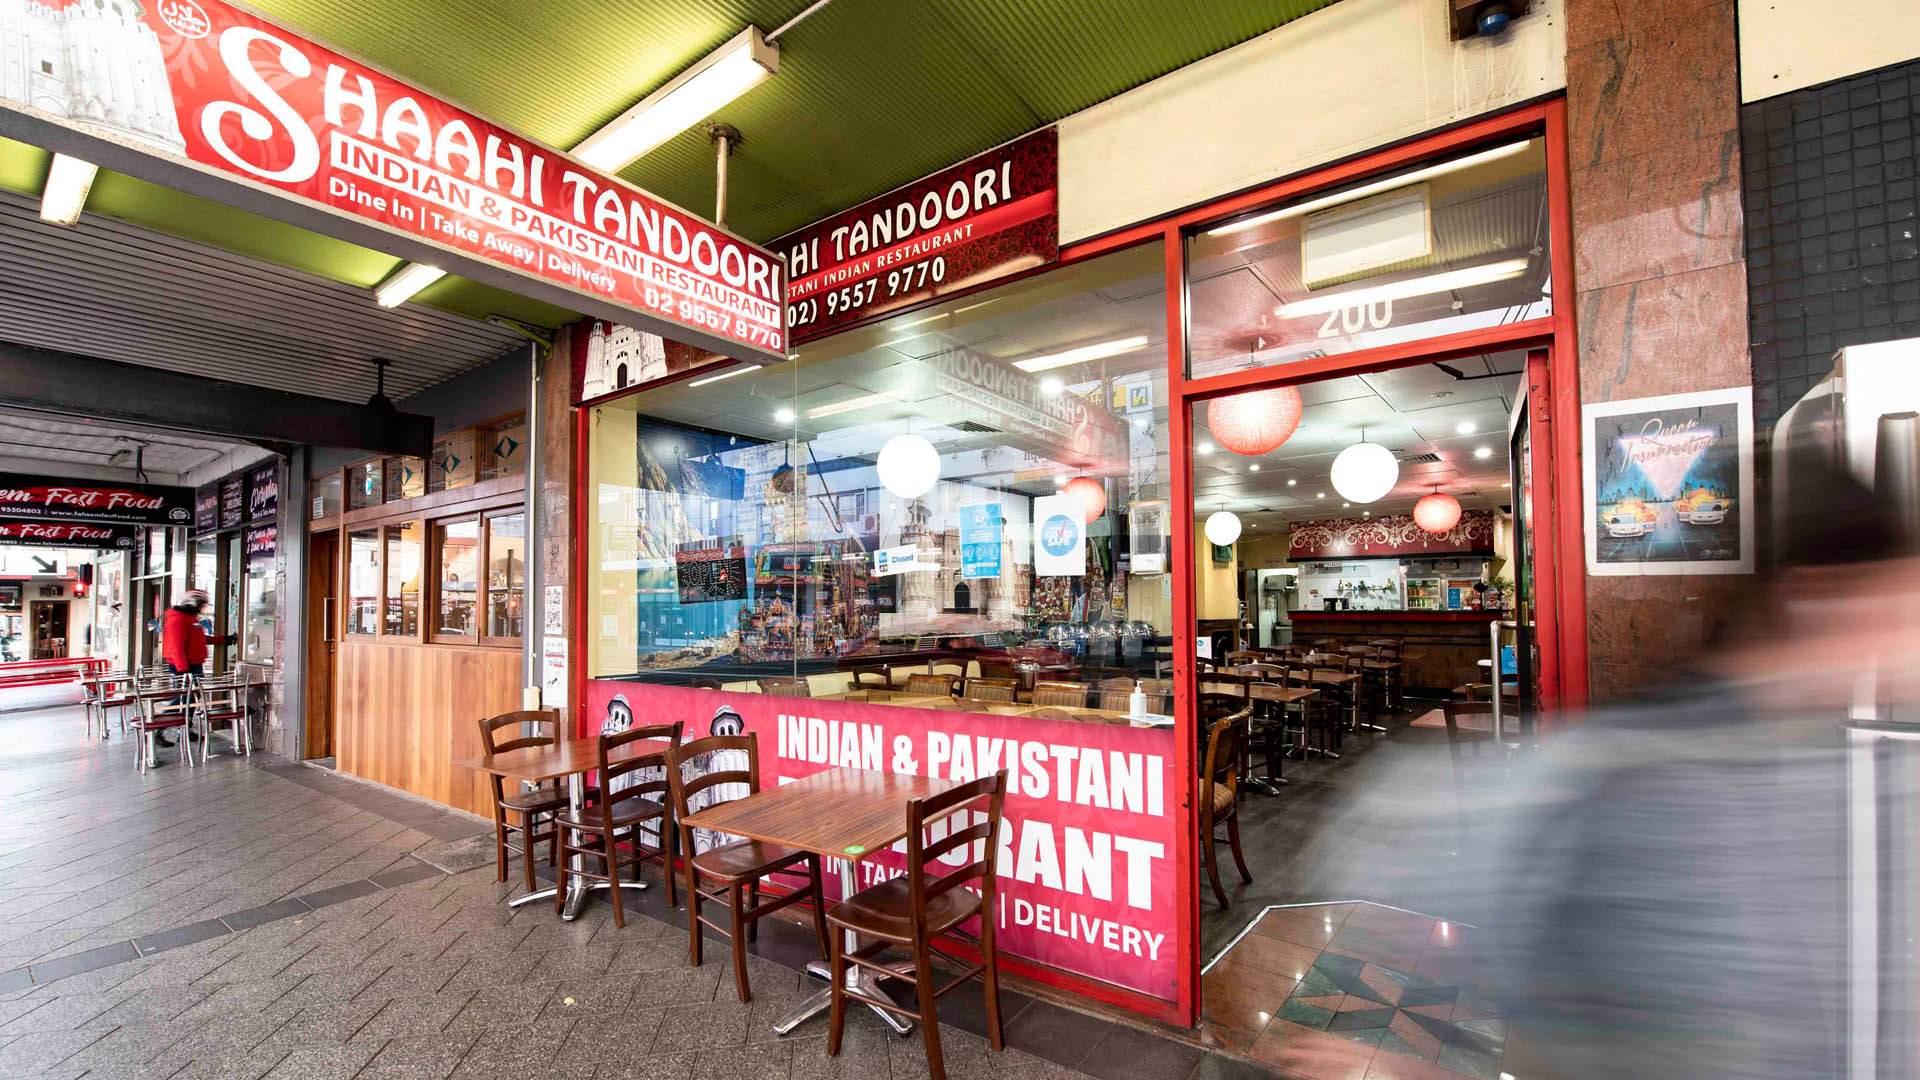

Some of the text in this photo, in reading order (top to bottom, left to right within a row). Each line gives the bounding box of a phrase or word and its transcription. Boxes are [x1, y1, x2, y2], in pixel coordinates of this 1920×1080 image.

[201, 26, 781, 302] SHAAHI TANDOORI
[329, 177, 617, 292] Dine In Take Away Delivery
[339, 140, 777, 321] INDIAN & PAKISTANI RESTAURANT
[791, 160, 1013, 278] HI TANDOORI
[823, 260, 871, 288] INDIAN
[877, 223, 973, 272] RESTAURANT
[827, 279, 877, 316] 9557
[887, 256, 946, 296] 9770
[644, 286, 782, 349] 02 9557 9770
[1318, 300, 1393, 339] 200
[1, 506, 41, 514] 95504803
[45, 488, 103, 508] Fast
[107, 493, 164, 510] Food
[20, 524, 65, 538] Fast
[68, 527, 113, 540] Food
[891, 554, 914, 564] Closed
[777, 714, 1165, 817] INDIAN & PAKISTANI
[861, 860, 909, 886] TAK
[1014, 898, 1166, 961] DELIVERY
